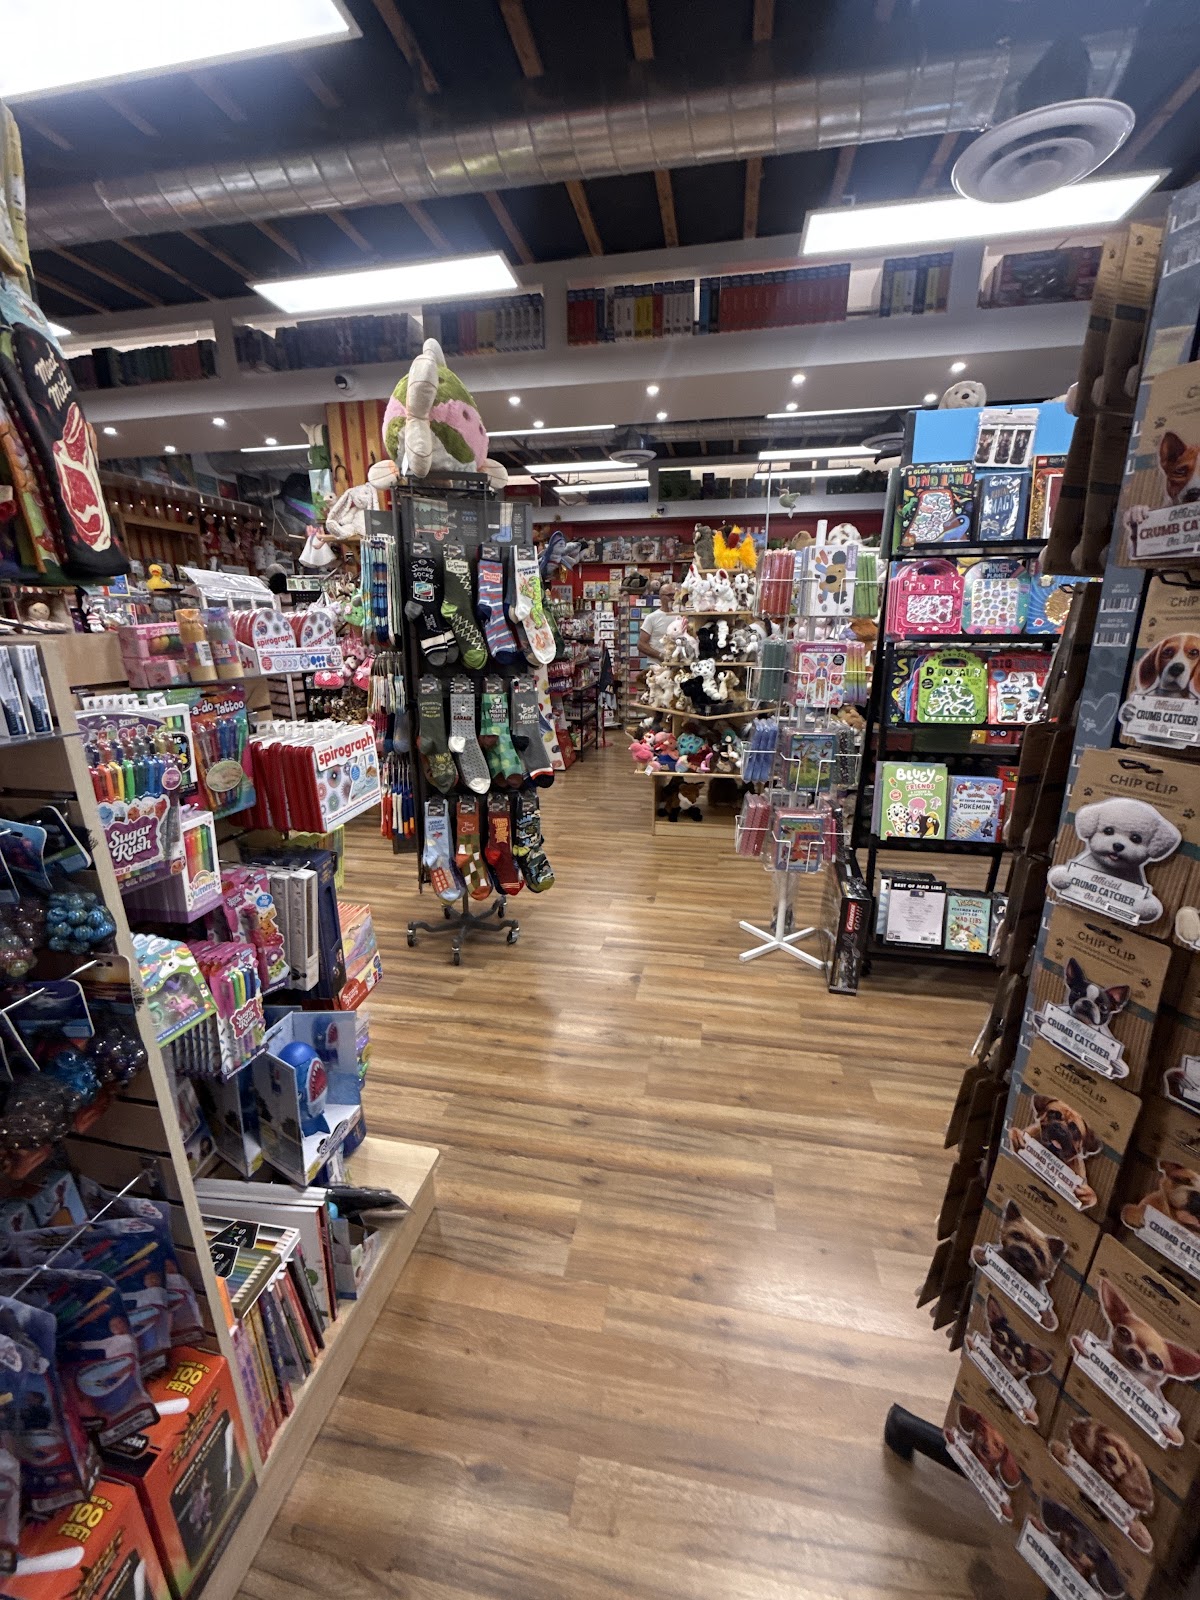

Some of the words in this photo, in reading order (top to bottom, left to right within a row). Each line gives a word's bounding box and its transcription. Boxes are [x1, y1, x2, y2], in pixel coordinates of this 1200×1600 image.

[34, 342, 60, 386] Meat
[47, 369, 72, 411] Mitt
[940, 473, 973, 487] LAND
[1140, 523, 1180, 540] CRUMB
[411, 564, 435, 575] Sunday
[413, 572, 434, 580] SOCKS
[982, 562, 1012, 573] PIXEL
[1170, 596, 1200, 608] CHIP
[256, 631, 293, 648] spirograph
[305, 628, 334, 648] pirograph
[214, 699, 245, 716] Tattoo
[1154, 700, 1185, 712] Official
[1136, 709, 1161, 722] CRUMB
[1163, 712, 1198, 726] CATCHER
[318, 731, 374, 767] spirograph
[896, 768, 936, 781] BLUEY
[905, 783, 935, 791] FRIENDS
[1110, 774, 1143, 788] CHIP
[1145, 780, 1179, 796] CLIP
[959, 803, 991, 811] POKÉMON
[108, 824, 152, 849] Sugar
[111, 835, 152, 862] Rush
[1070, 877, 1098, 895] CRUMB
[1099, 887, 1137, 907] CATCHER
[1090, 874, 1123, 891] Official
[846, 904, 856, 931] Carrera
[1078, 931, 1105, 948] CHIP
[1108, 945, 1136, 962] CLIP
[236, 1003, 255, 1021] Sugar
[236, 1011, 256, 1030] Rush
[1047, 1017, 1074, 1038] CRUMB
[1074, 1033, 1110, 1060] CATCHER
[1054, 1065, 1080, 1085] CHIP
[1081, 1084, 1107, 1103] CLIP
[1026, 1145, 1047, 1165] CRUMB
[1047, 1162, 1074, 1189] CATCHER
[1149, 1221, 1178, 1246] CRUMB
[988, 1258, 1011, 1281] CRUMB
[1010, 1279, 1041, 1310] CATCHER
[172, 1366, 203, 1386] 100
[165, 1381, 194, 1396] FEET!
[1089, 1352, 1119, 1384] CRUMB
[1119, 1380, 1160, 1422] CATCHER
[67, 1503, 104, 1528] 100
